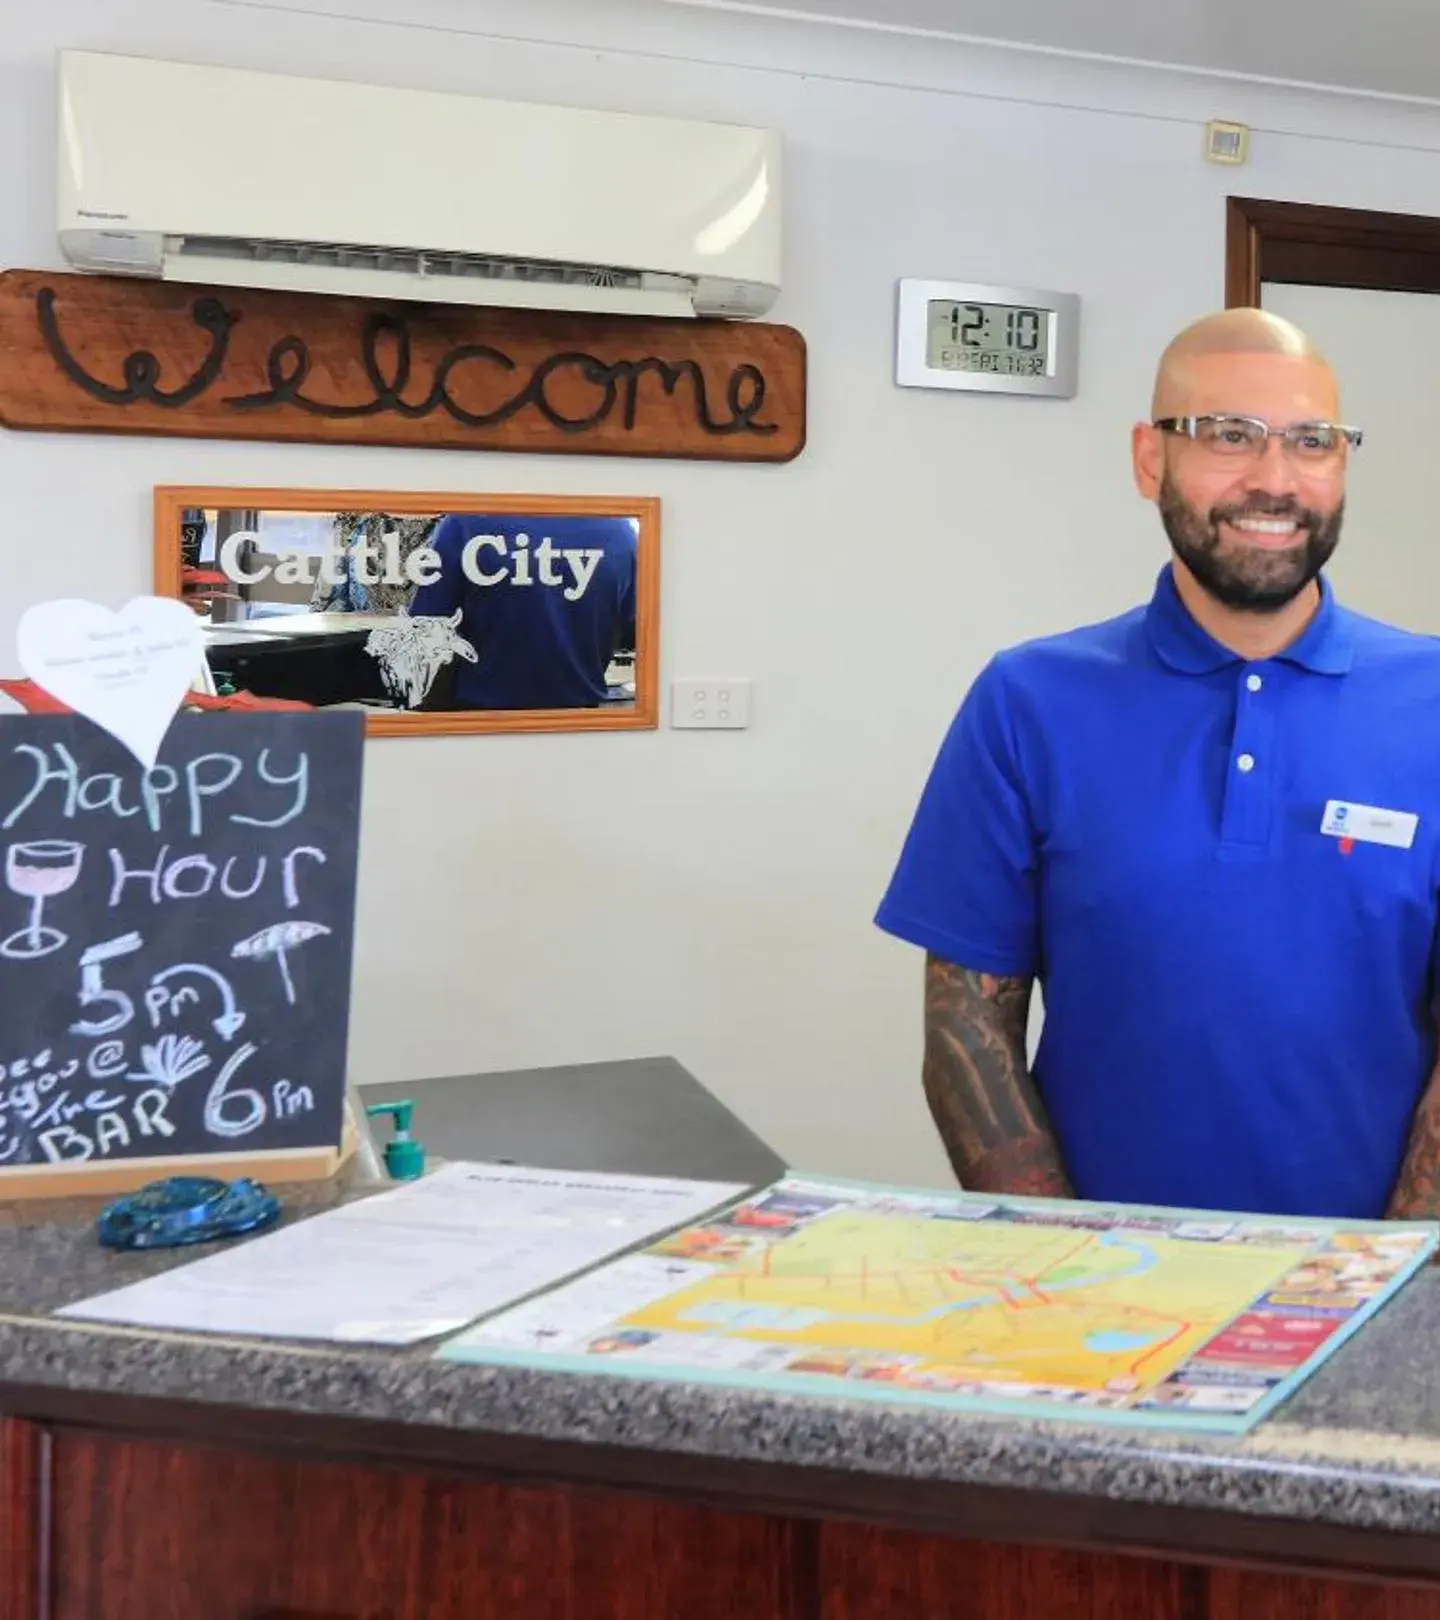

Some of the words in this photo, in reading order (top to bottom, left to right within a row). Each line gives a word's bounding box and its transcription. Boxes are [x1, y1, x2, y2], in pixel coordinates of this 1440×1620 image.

[36, 286, 778, 436] Welcome
[951, 305, 1039, 350] 12:10
[219, 530, 443, 588] Cattle
[461, 532, 604, 600] City
[2, 742, 309, 836] Happy
[108, 844, 327, 909] Hour
[68, 931, 144, 1036] 5
[37, 1088, 176, 1164] BAR
[203, 1042, 268, 1137] 6
